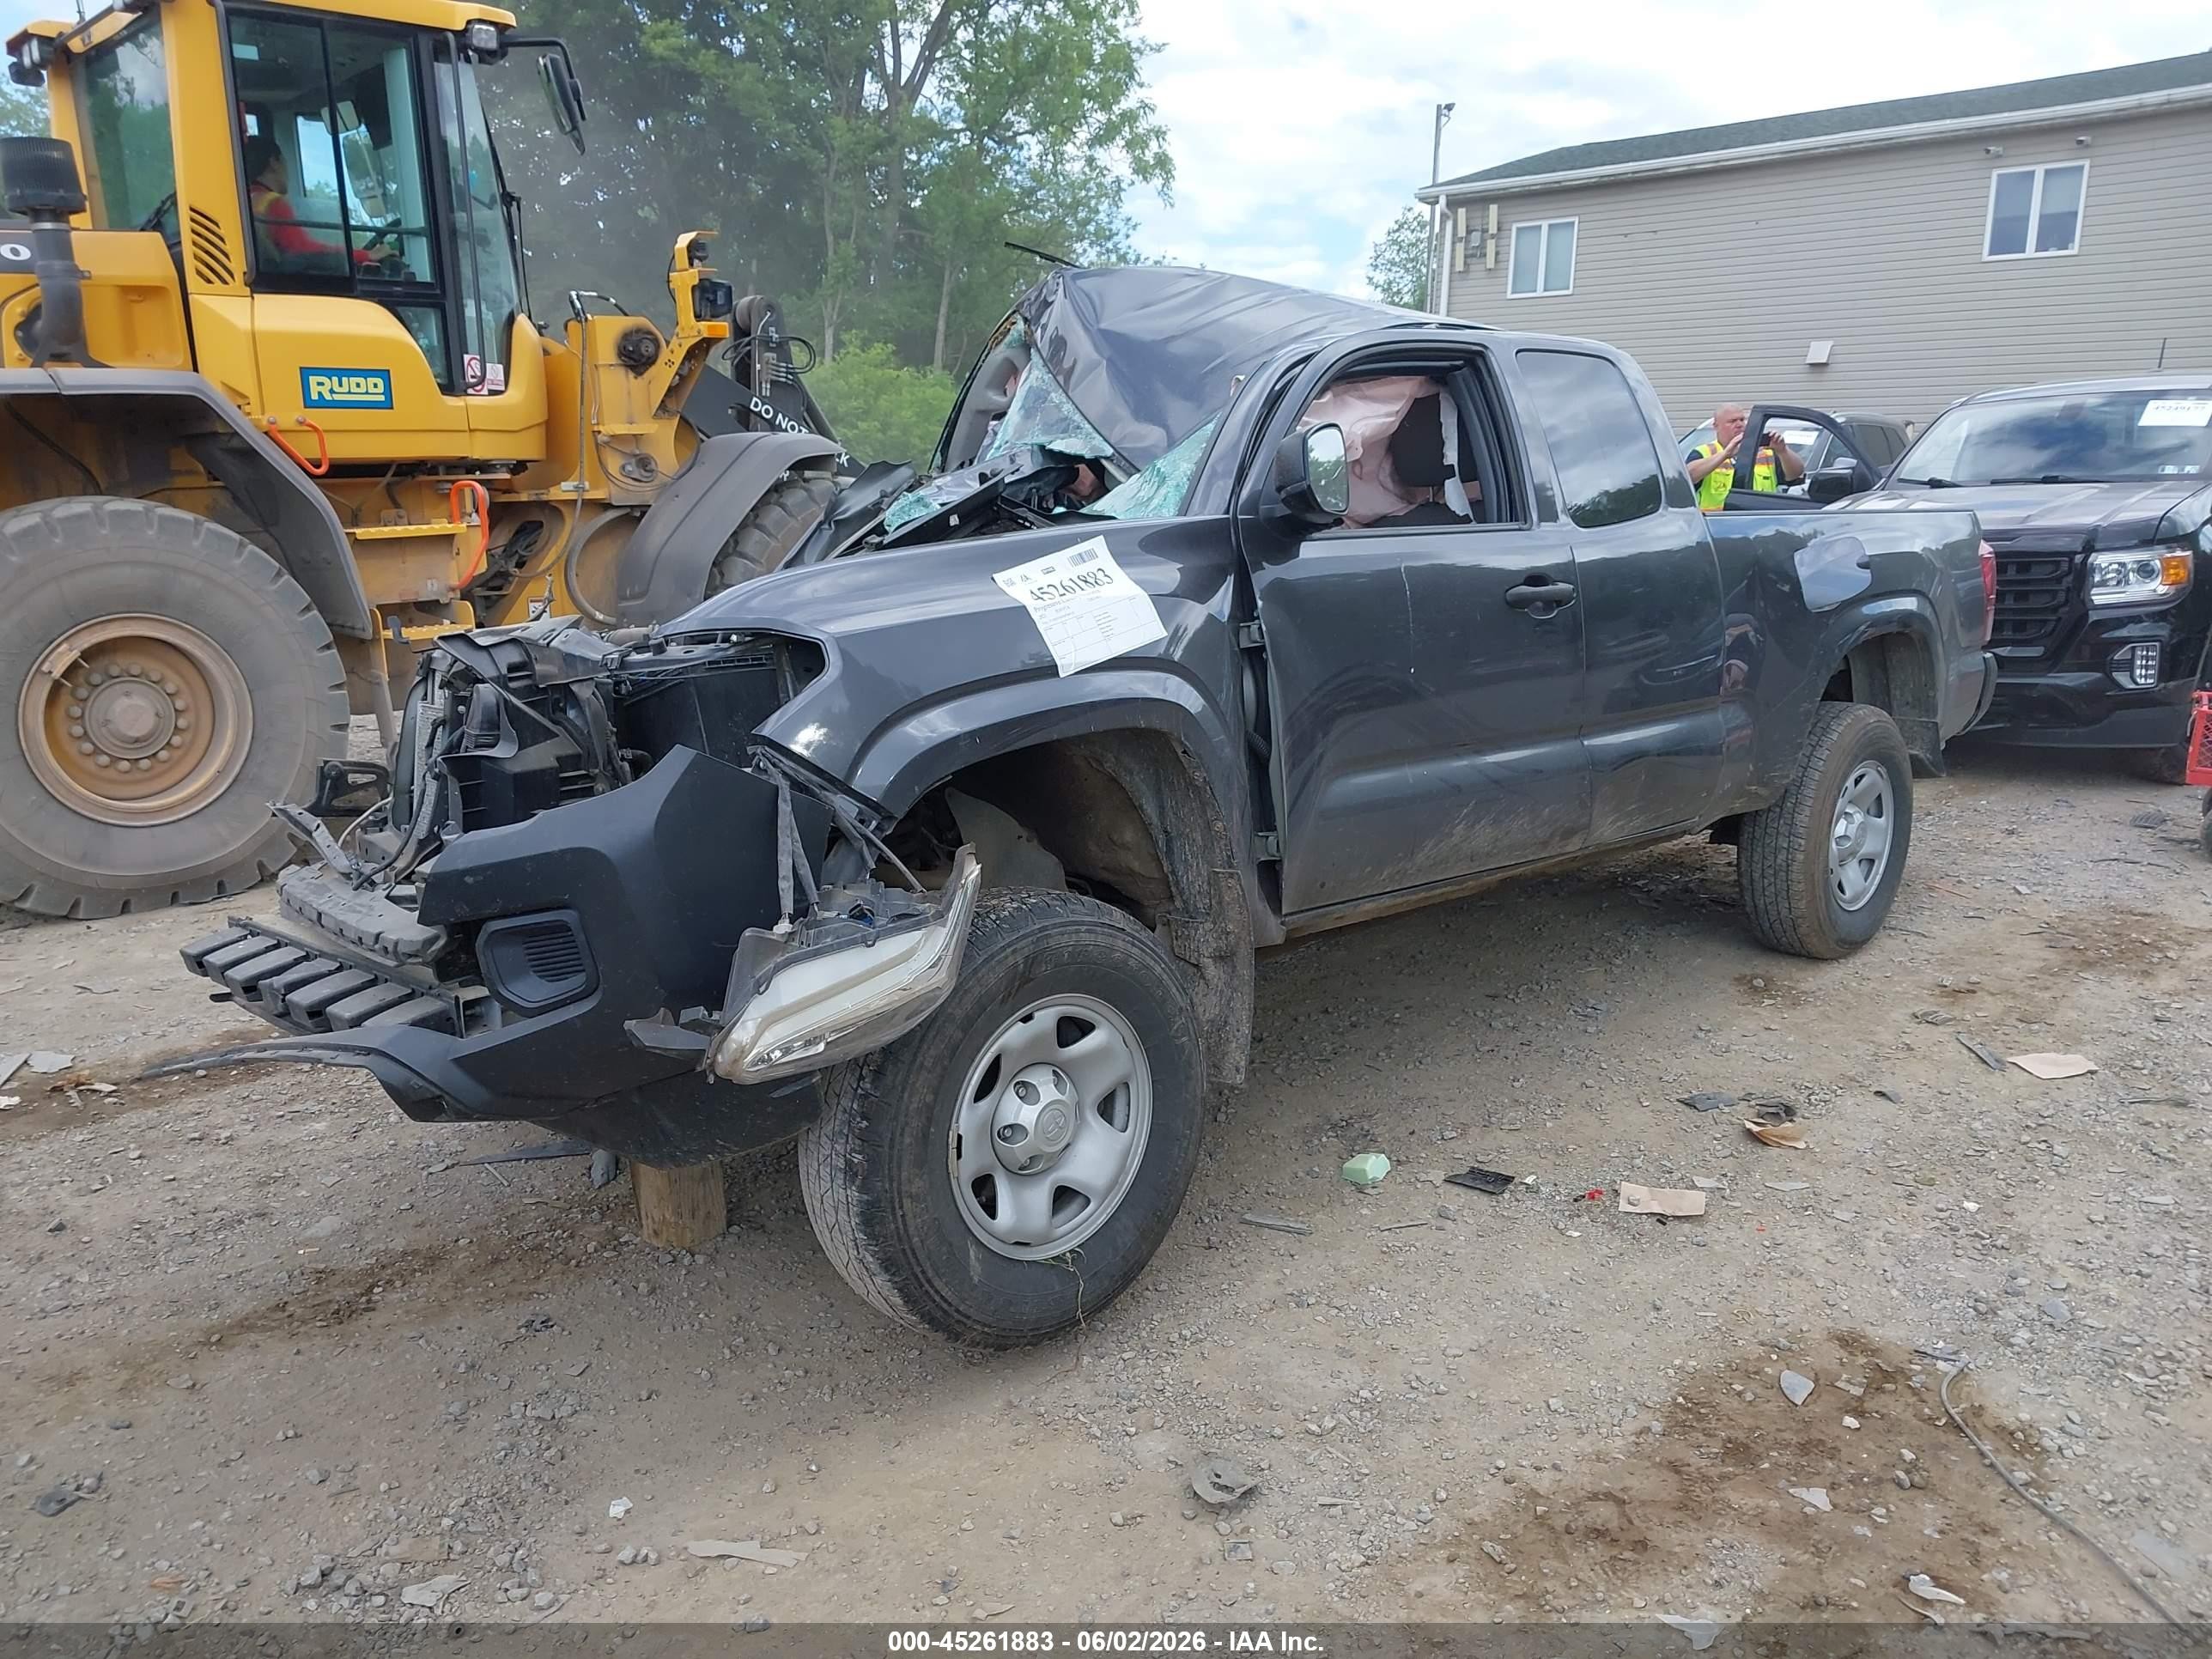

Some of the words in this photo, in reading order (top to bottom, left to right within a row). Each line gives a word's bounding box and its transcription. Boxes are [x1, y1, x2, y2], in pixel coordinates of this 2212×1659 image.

[308, 375, 385, 400] RUDD
[750, 397, 774, 419] DO
[1030, 567, 1114, 602] 45261883
